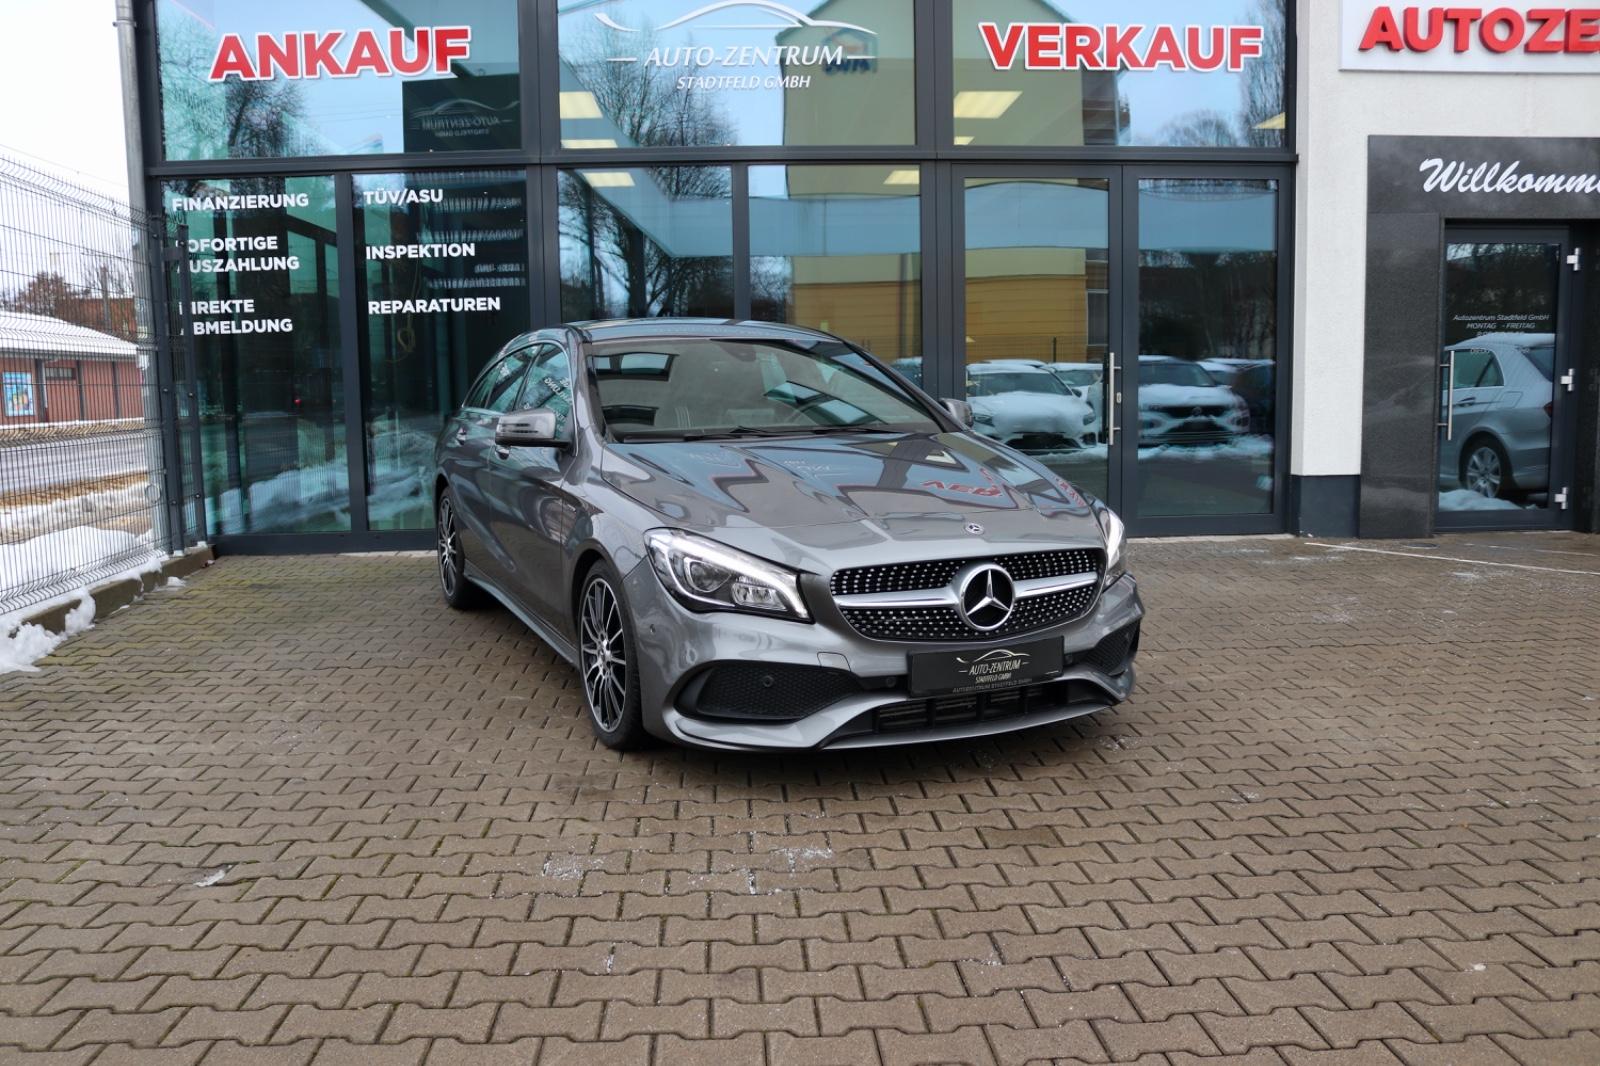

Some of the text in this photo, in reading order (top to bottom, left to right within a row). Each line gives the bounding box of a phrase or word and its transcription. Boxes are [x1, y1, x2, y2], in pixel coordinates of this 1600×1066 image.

[209, 26, 471, 81] ANKAUF
[979, 22, 1264, 72] VERKAUF
[644, 46, 844, 67] AUTO-ZENTRUM
[677, 75, 811, 90] STADTFELD GMBH
[172, 193, 309, 211] FINANZIERUNG
[363, 188, 444, 206] TÜV/ASU
[176, 236, 278, 253] OFORTIGE
[366, 243, 476, 260] INSPEKTION
[177, 256, 300, 273] USZAHLUNG
[179, 299, 255, 315] IREKTE
[368, 297, 501, 315] REPARATUREN
[180, 318, 293, 335] BMELDUNG
[969, 659, 1021, 676] AUTO-ZENTRUM
